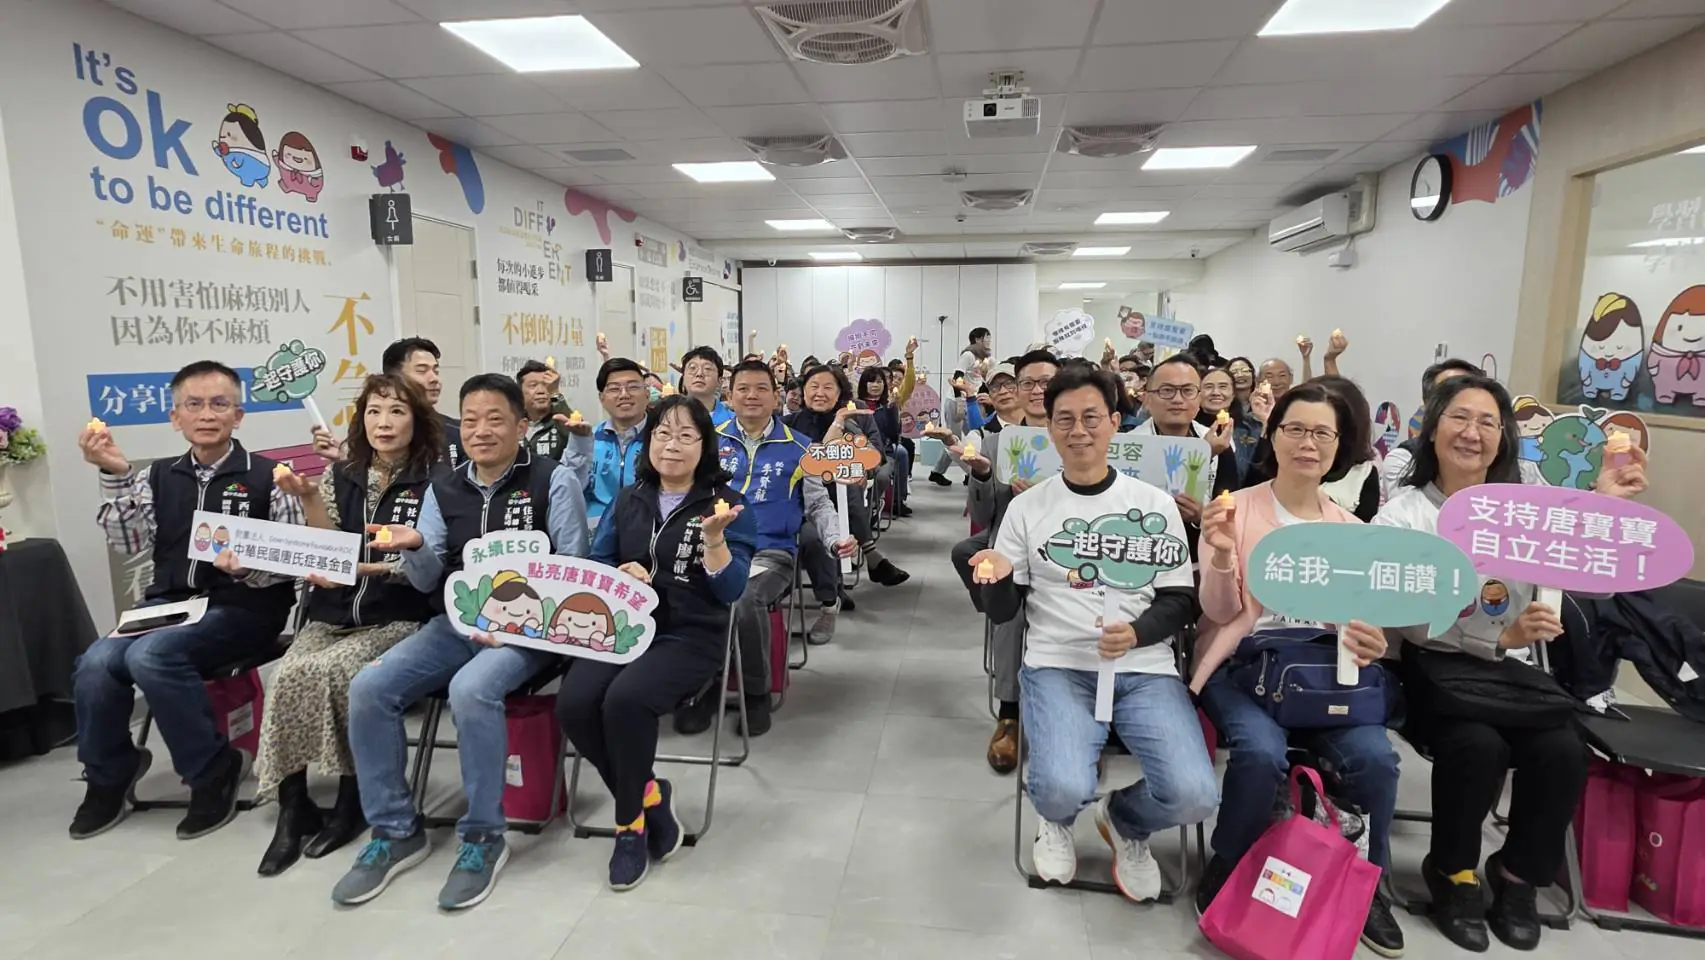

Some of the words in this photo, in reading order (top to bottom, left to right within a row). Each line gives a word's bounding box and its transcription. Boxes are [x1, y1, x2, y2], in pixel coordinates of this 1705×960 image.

[72, 41, 138, 95] It's
[89, 165, 134, 204] to
[147, 174, 193, 216] be
[204, 189, 330, 239] different
[103, 275, 310, 315] 不用害怕麻煩別人
[110, 314, 272, 347] 因為你不麻煩
[500, 312, 585, 347] 不倒的力量
[250, 350, 325, 393] 一起守護你
[811, 444, 855, 461] 不倒的
[836, 462, 866, 479] 力量
[1467, 495, 1660, 549] 支持唐寶寶
[233, 544, 353, 574] 中華民國唐氏症基金會
[470, 538, 541, 564] 永續ESG
[1047, 530, 1183, 565] 一起守護你
[1470, 528, 1649, 582] 自立生活！
[527, 560, 652, 613] 點亮唐寶寶希望
[1263, 551, 1462, 597] 給我一個讚！
